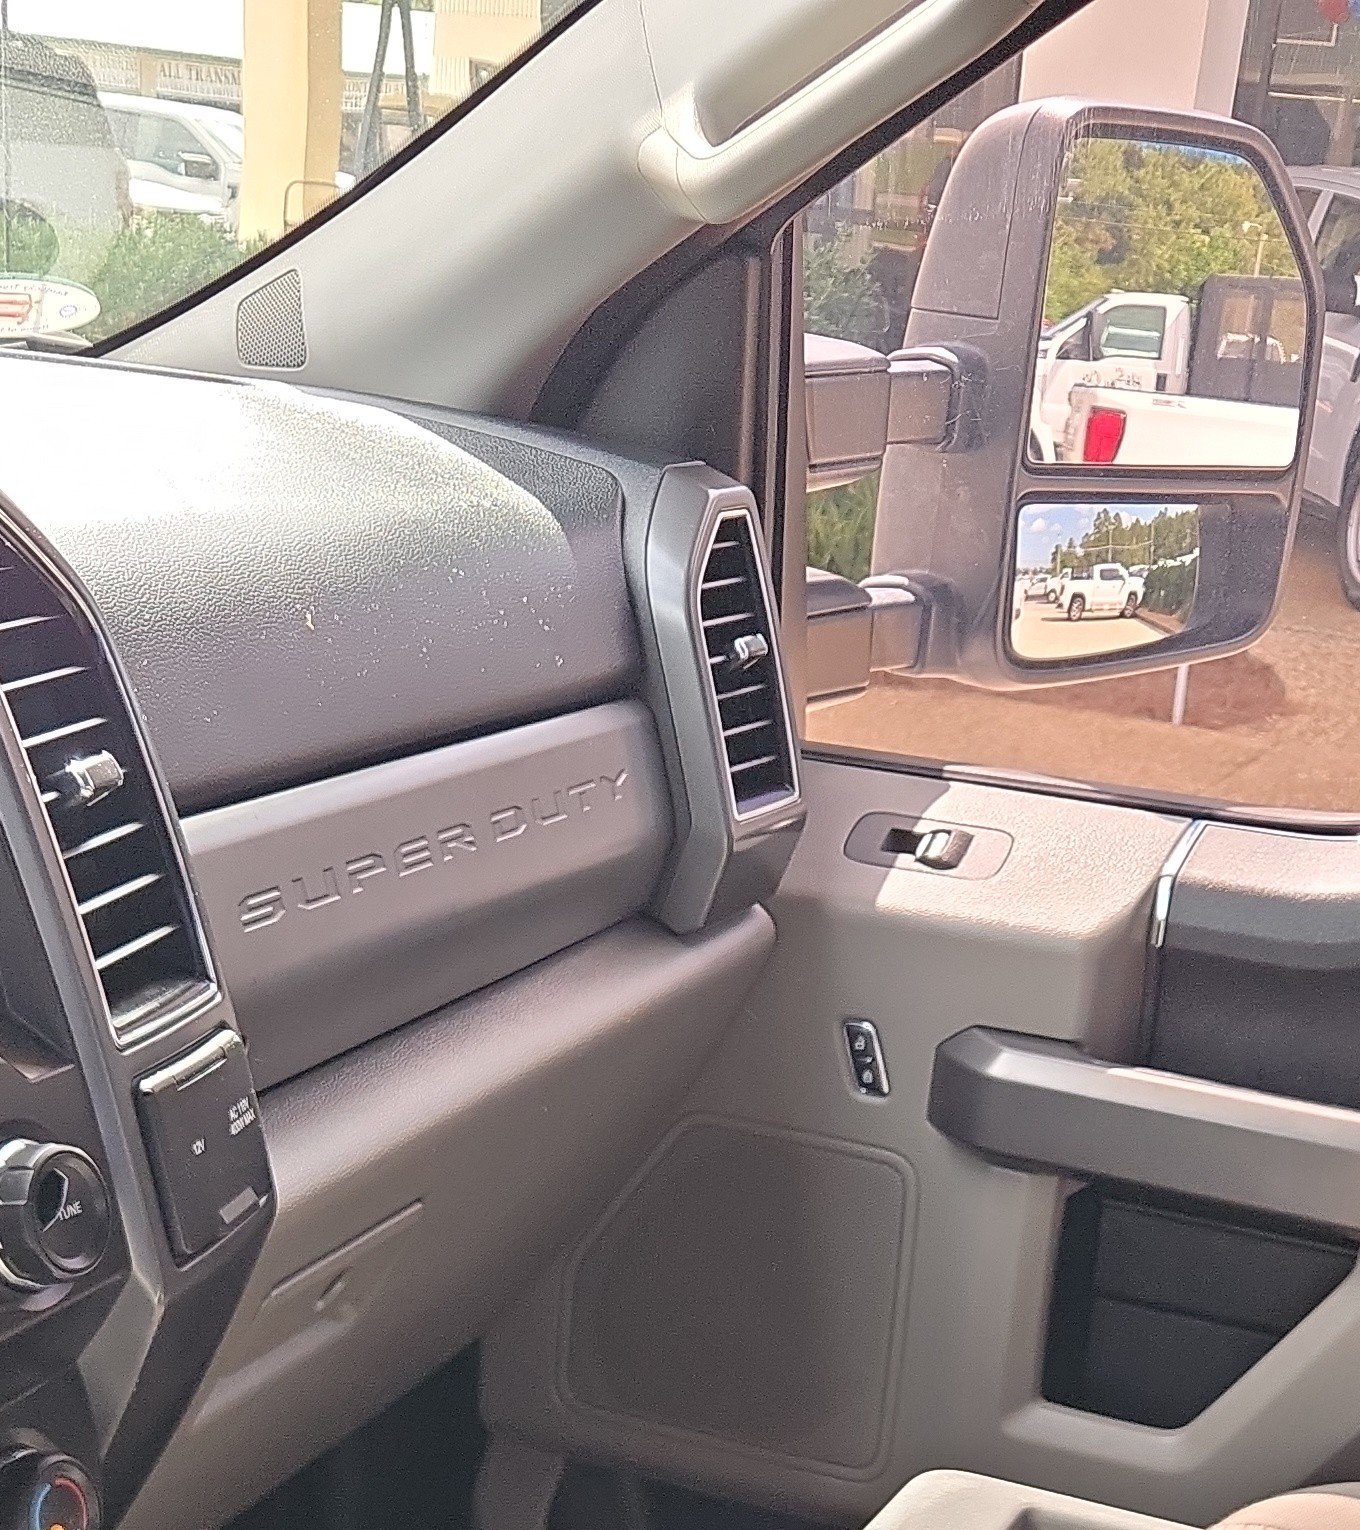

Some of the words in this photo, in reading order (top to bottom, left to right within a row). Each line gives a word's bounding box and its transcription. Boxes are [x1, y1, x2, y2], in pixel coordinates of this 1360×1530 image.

[239, 822, 478, 934] SUPER
[489, 767, 630, 843] DUTY
[192, 1138, 207, 1156] 12V
